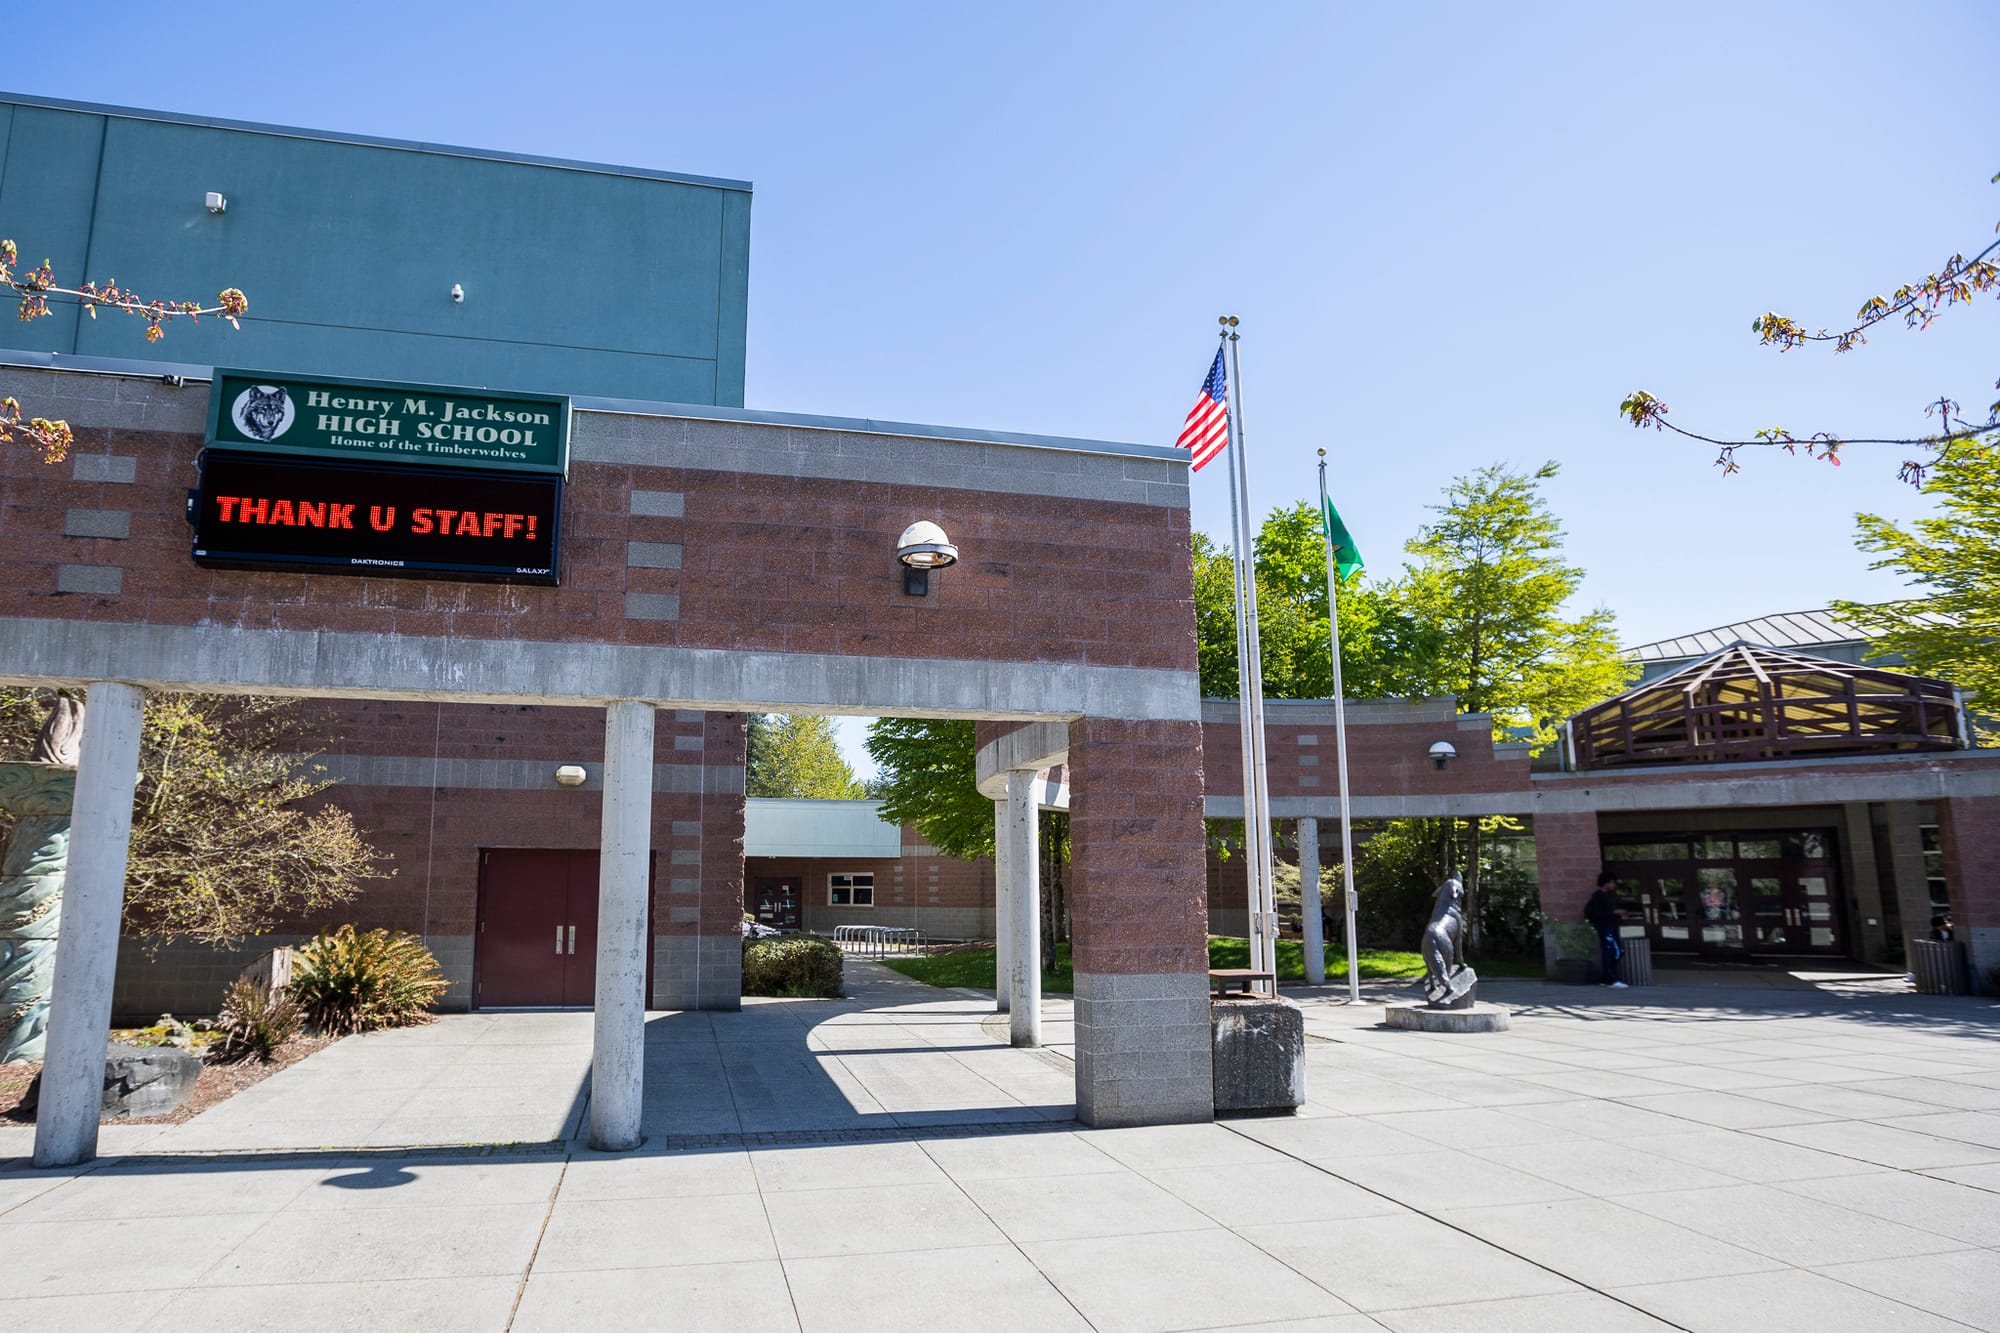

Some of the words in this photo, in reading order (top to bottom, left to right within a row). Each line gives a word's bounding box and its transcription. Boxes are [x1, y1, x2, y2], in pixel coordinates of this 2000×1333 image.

[307, 390, 394, 417] Henry
[402, 398, 435, 417] M.
[441, 401, 550, 425] Jackson
[317, 415, 400, 436] HIGH
[417, 422, 537, 447] SCHOOL
[330, 436, 375, 448] Home
[380, 438, 396, 450] of
[399, 440, 422, 451] the
[426, 443, 526, 459] Timberwolves
[217, 496, 355, 529] THANK
[370, 506, 395, 532] U
[411, 508, 537, 540] STAFF!
[351, 559, 404, 567] DAKTRONICS
